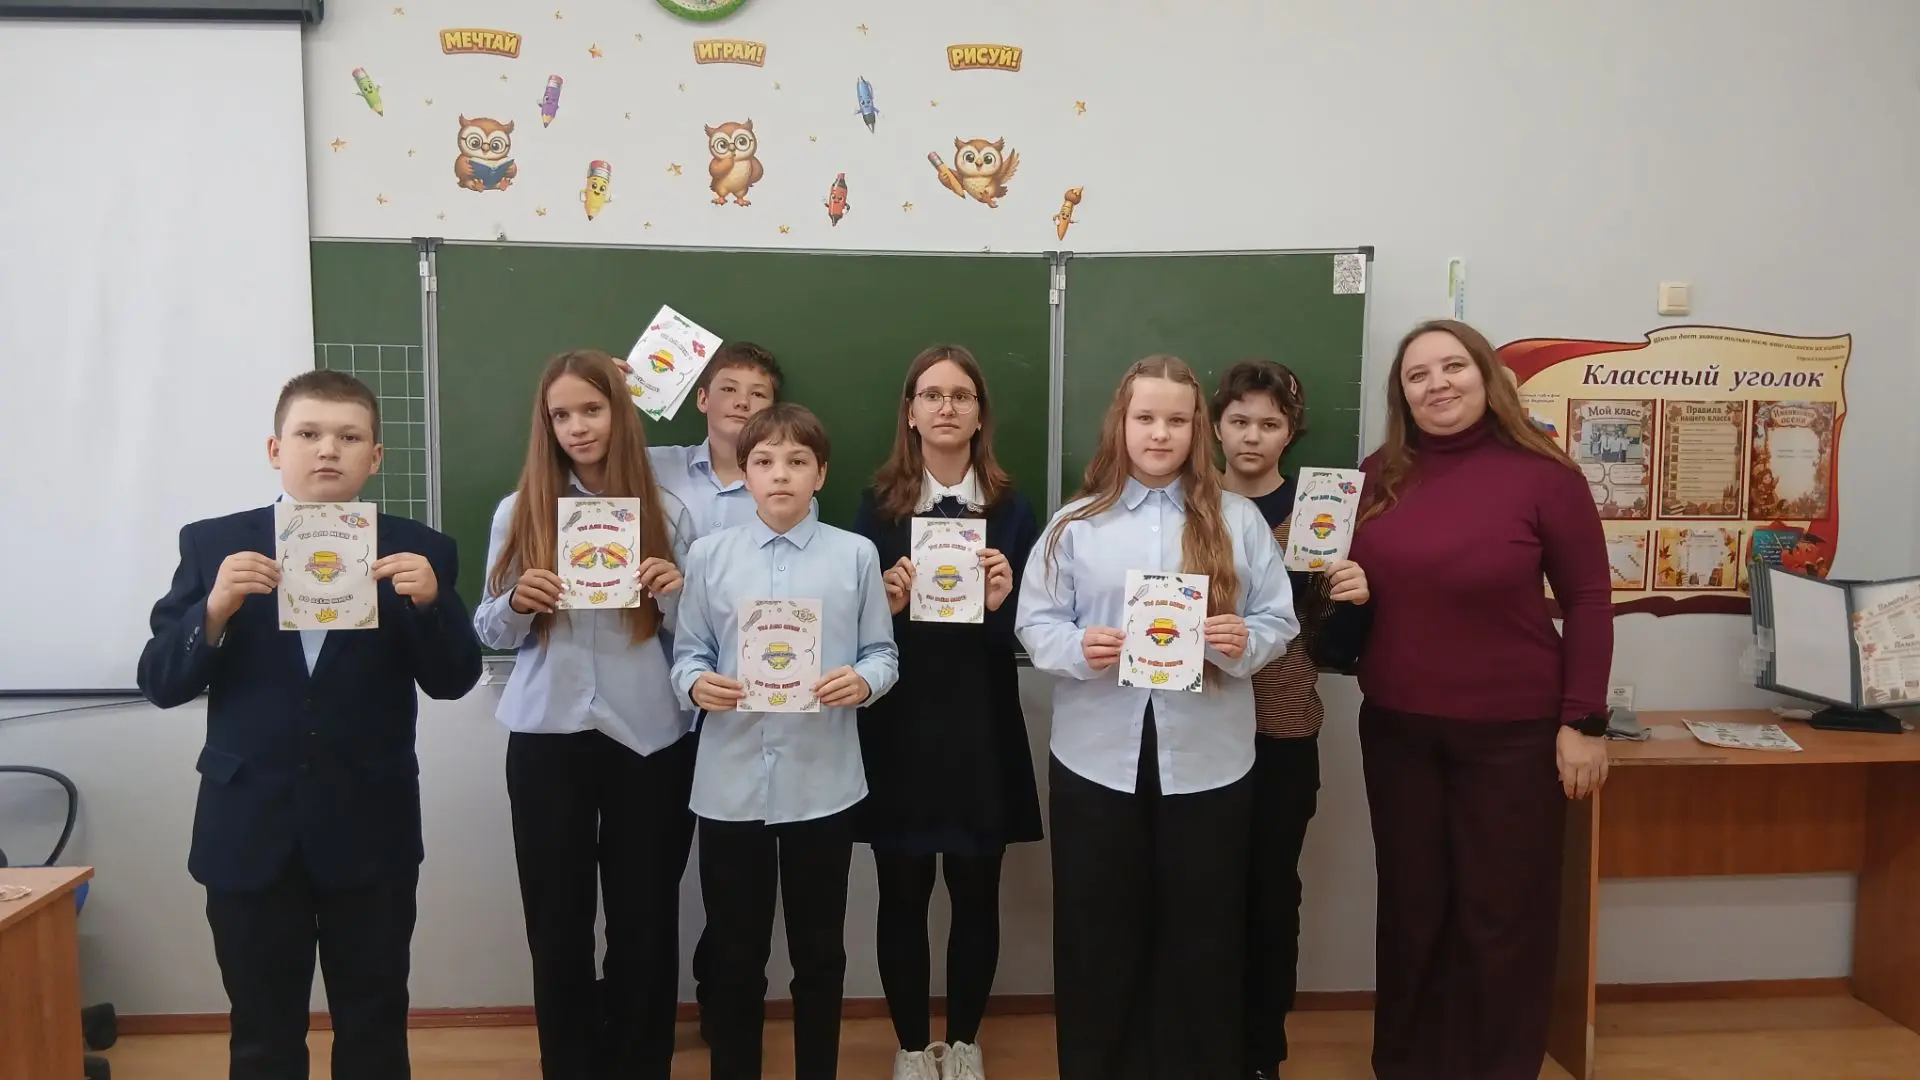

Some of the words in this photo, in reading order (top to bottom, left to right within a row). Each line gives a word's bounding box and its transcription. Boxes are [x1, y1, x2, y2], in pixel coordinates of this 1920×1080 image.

[443, 31, 518, 54] МЕЧТАЙ
[698, 42, 764, 62] ИГРАЙ!
[951, 46, 1020, 67] РИСУЙ!
[1582, 363, 1720, 387] Классный
[1728, 369, 1824, 392] уголок
[1588, 405, 1612, 417] Мой
[1614, 406, 1641, 417] класс
[1686, 405, 1722, 415] Правила
